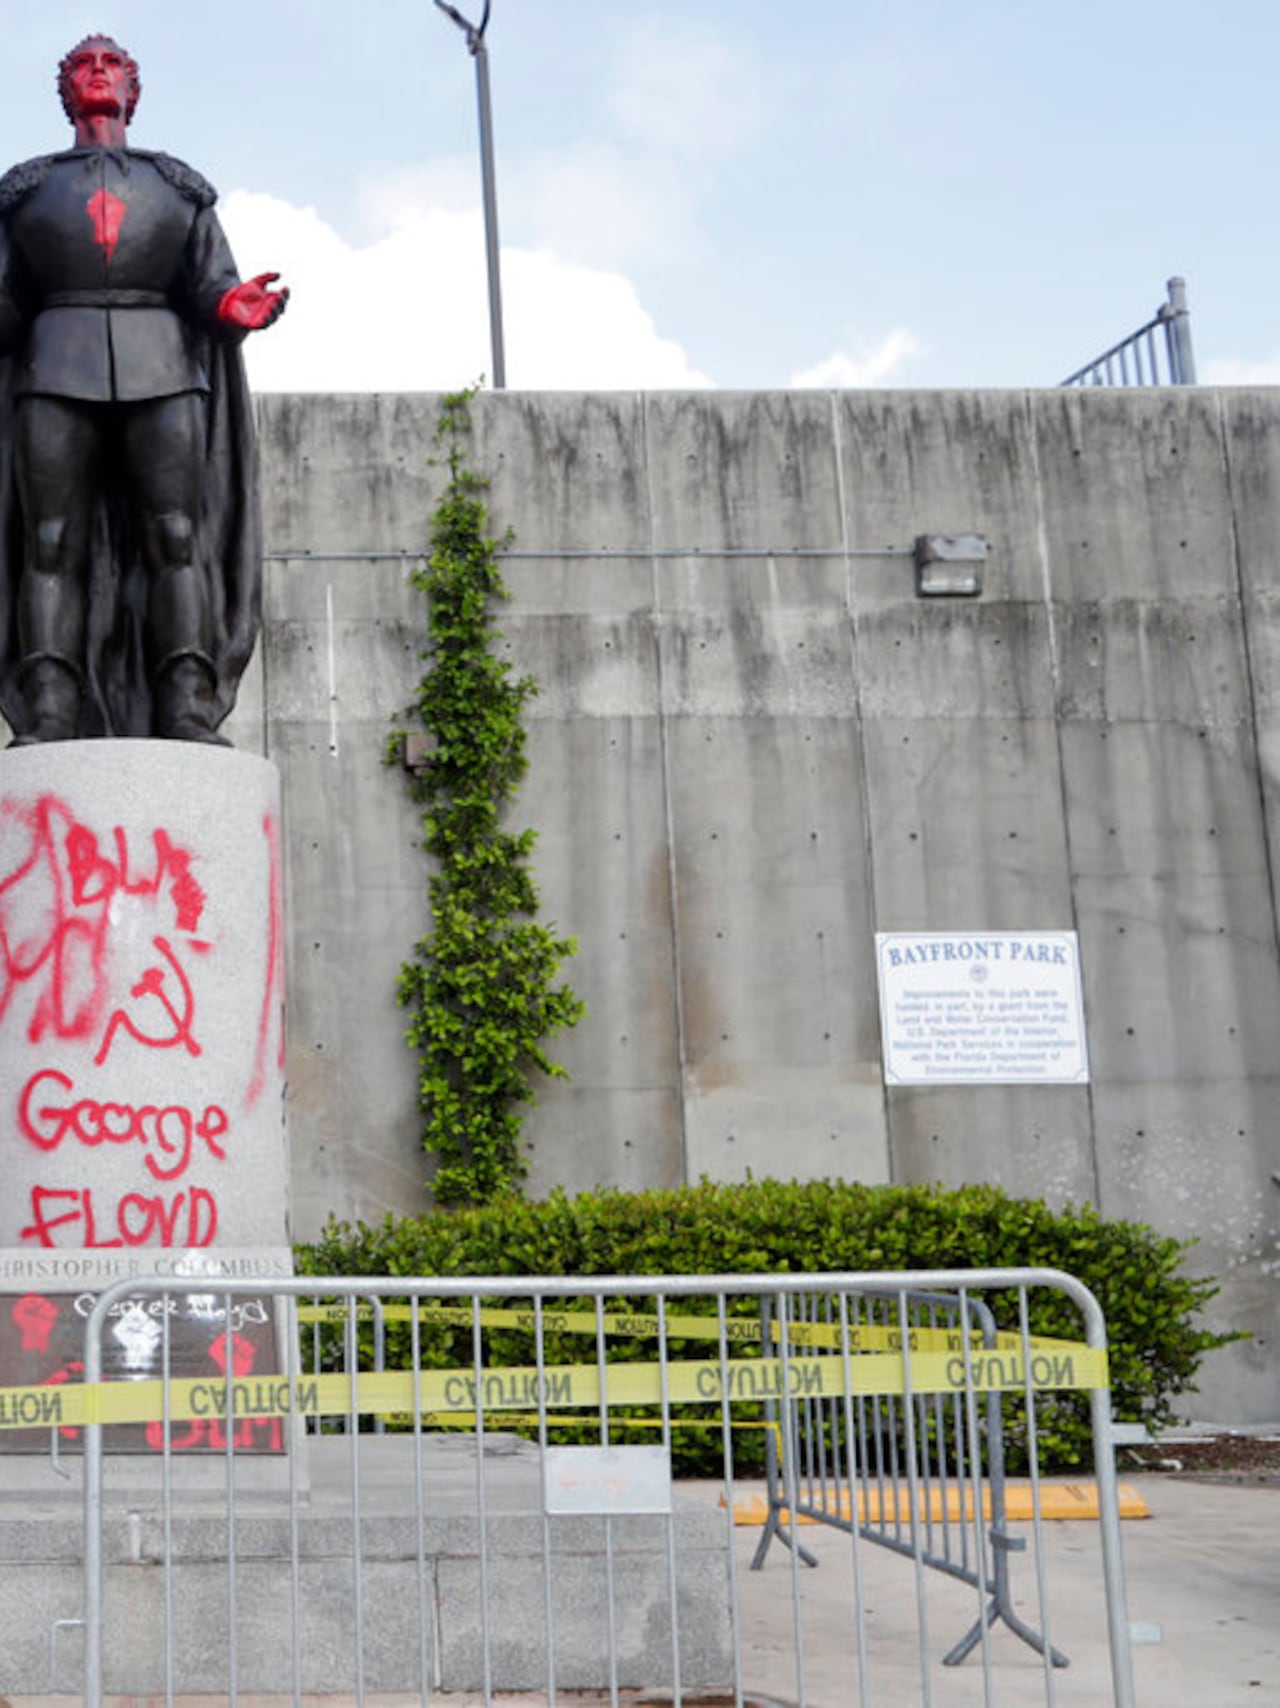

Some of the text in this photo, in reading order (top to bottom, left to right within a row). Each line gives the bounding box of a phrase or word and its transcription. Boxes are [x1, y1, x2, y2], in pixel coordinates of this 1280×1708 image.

[888, 941, 1067, 966] BAYFRONT PARK
[20, 1069, 230, 1180] George
[21, 1185, 219, 1248] FLOYD
